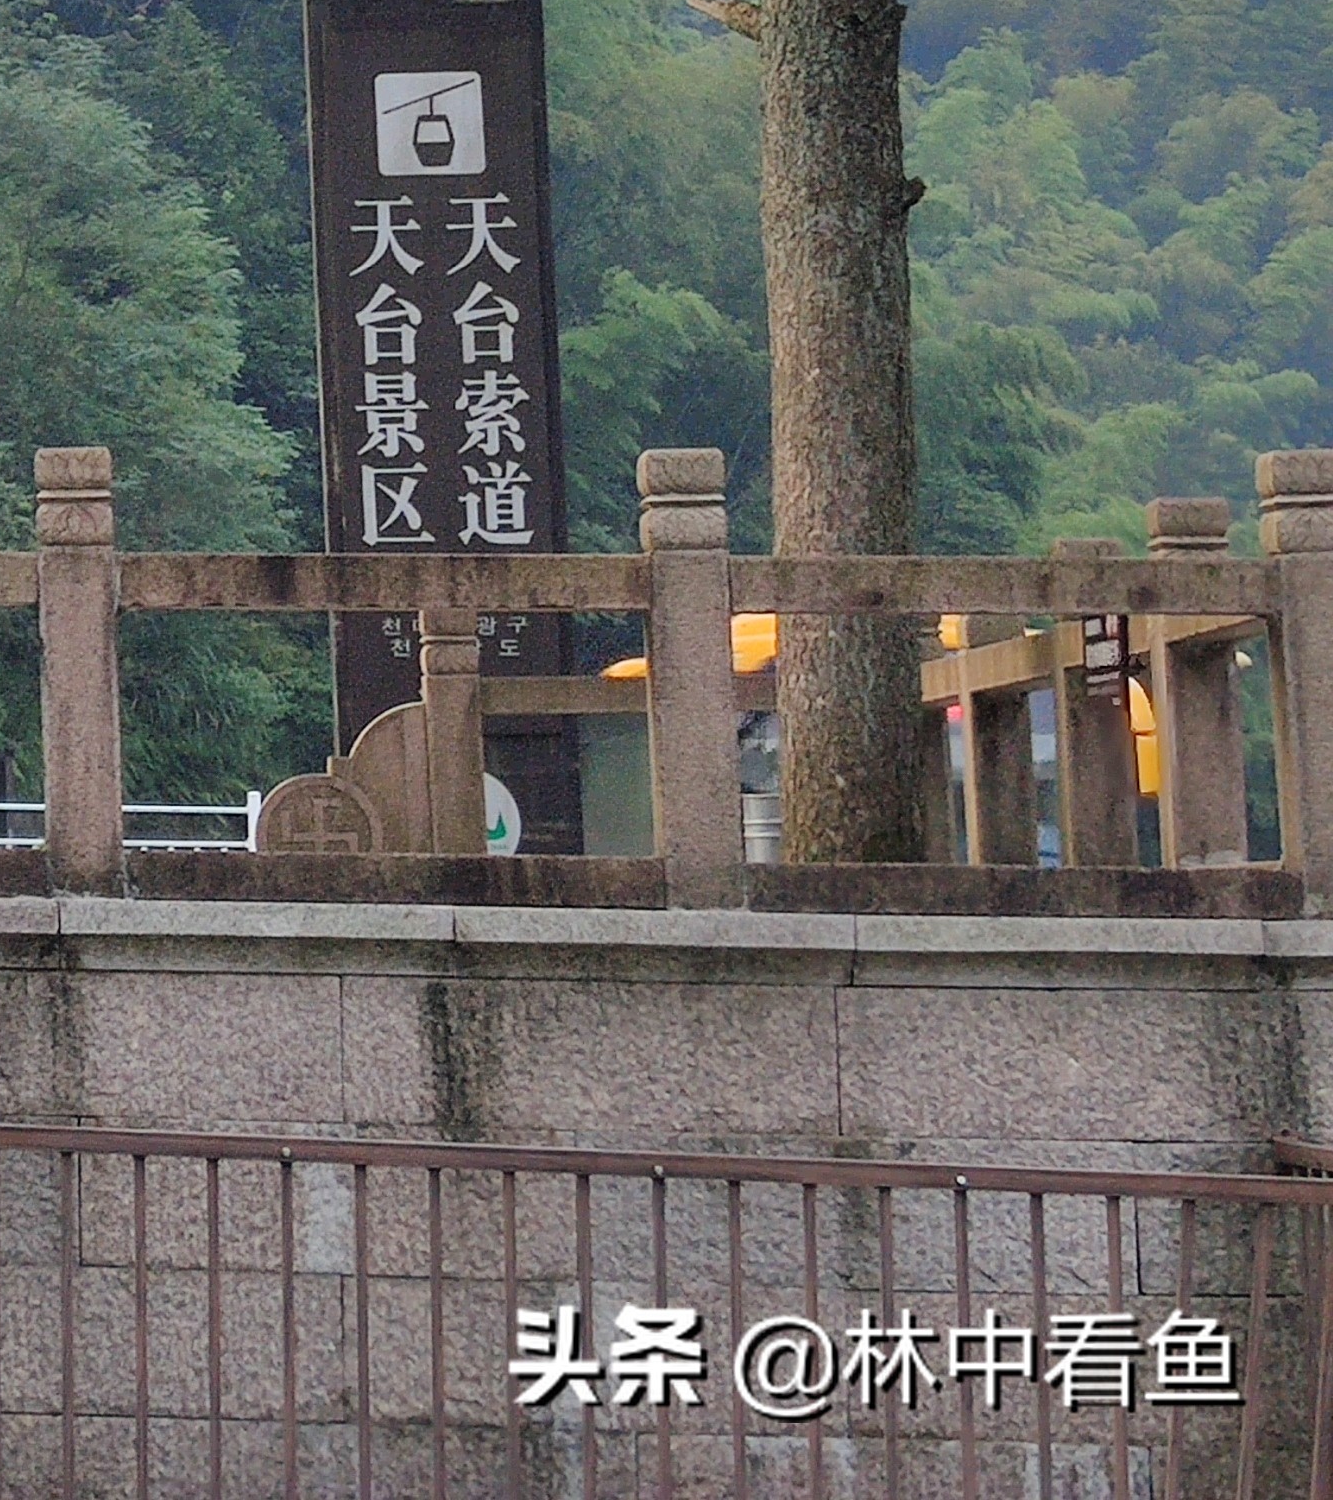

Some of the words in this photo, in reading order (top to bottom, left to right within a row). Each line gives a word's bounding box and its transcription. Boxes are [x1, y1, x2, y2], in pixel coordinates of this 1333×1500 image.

[348, 195, 435, 547] 天台景区
[446, 192, 535, 547] 天台索道
